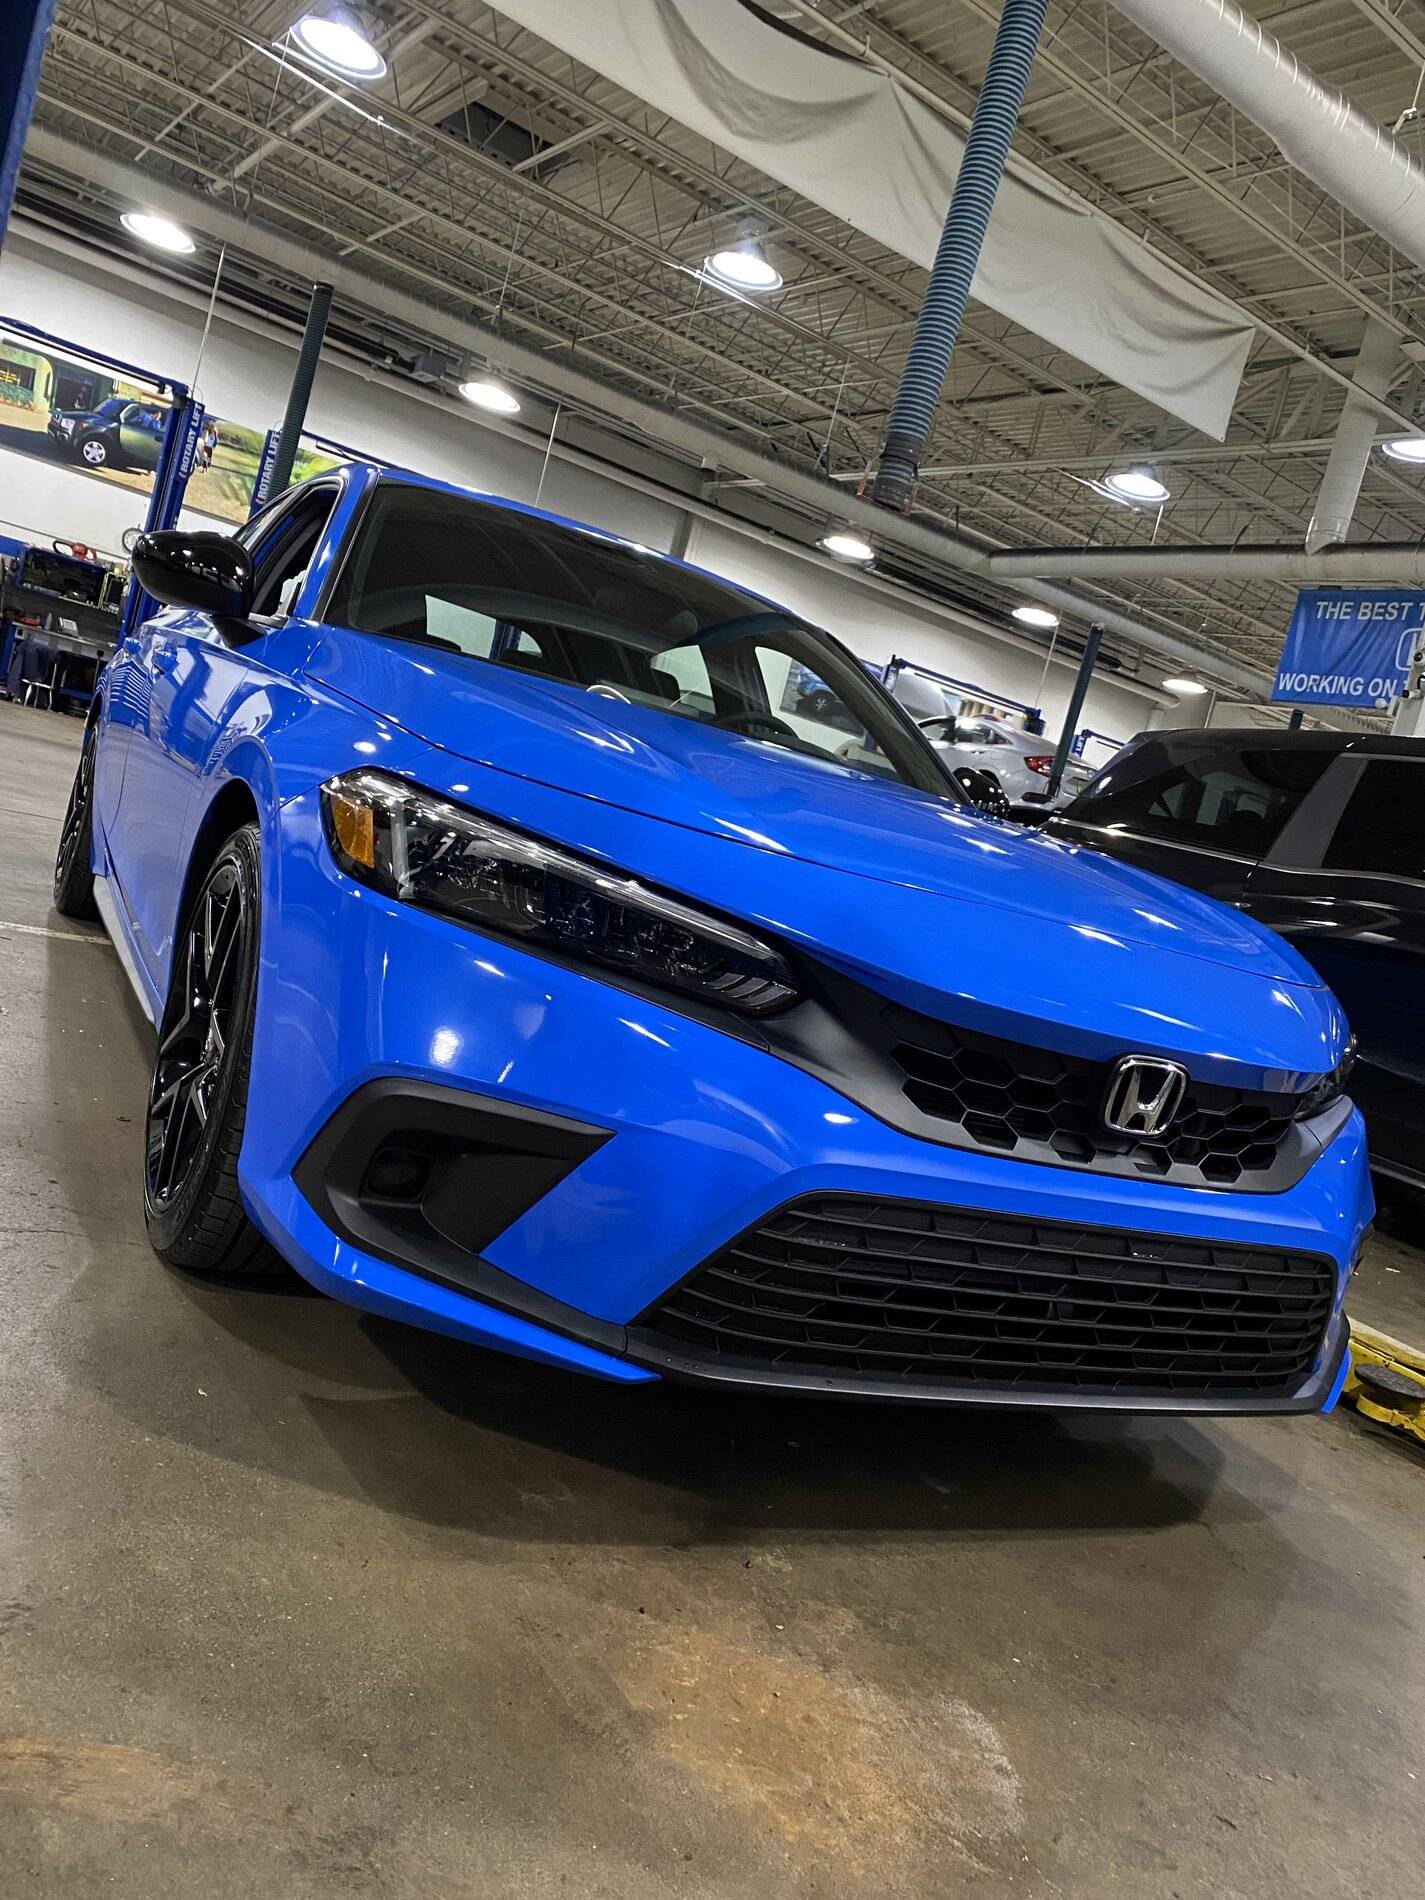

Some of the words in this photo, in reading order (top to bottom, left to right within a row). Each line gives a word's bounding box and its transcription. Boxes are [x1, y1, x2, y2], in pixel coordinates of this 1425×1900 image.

[180, 428, 197, 474] ROTARY
[191, 402, 202, 427] LIFT
[257, 455, 274, 499] ROTARY
[267, 431, 281, 455] LIFT
[1316, 601, 1354, 620] THE
[1357, 602, 1413, 621] BEST
[1278, 672, 1363, 696] WORKING
[1368, 678, 1397, 697] ON
